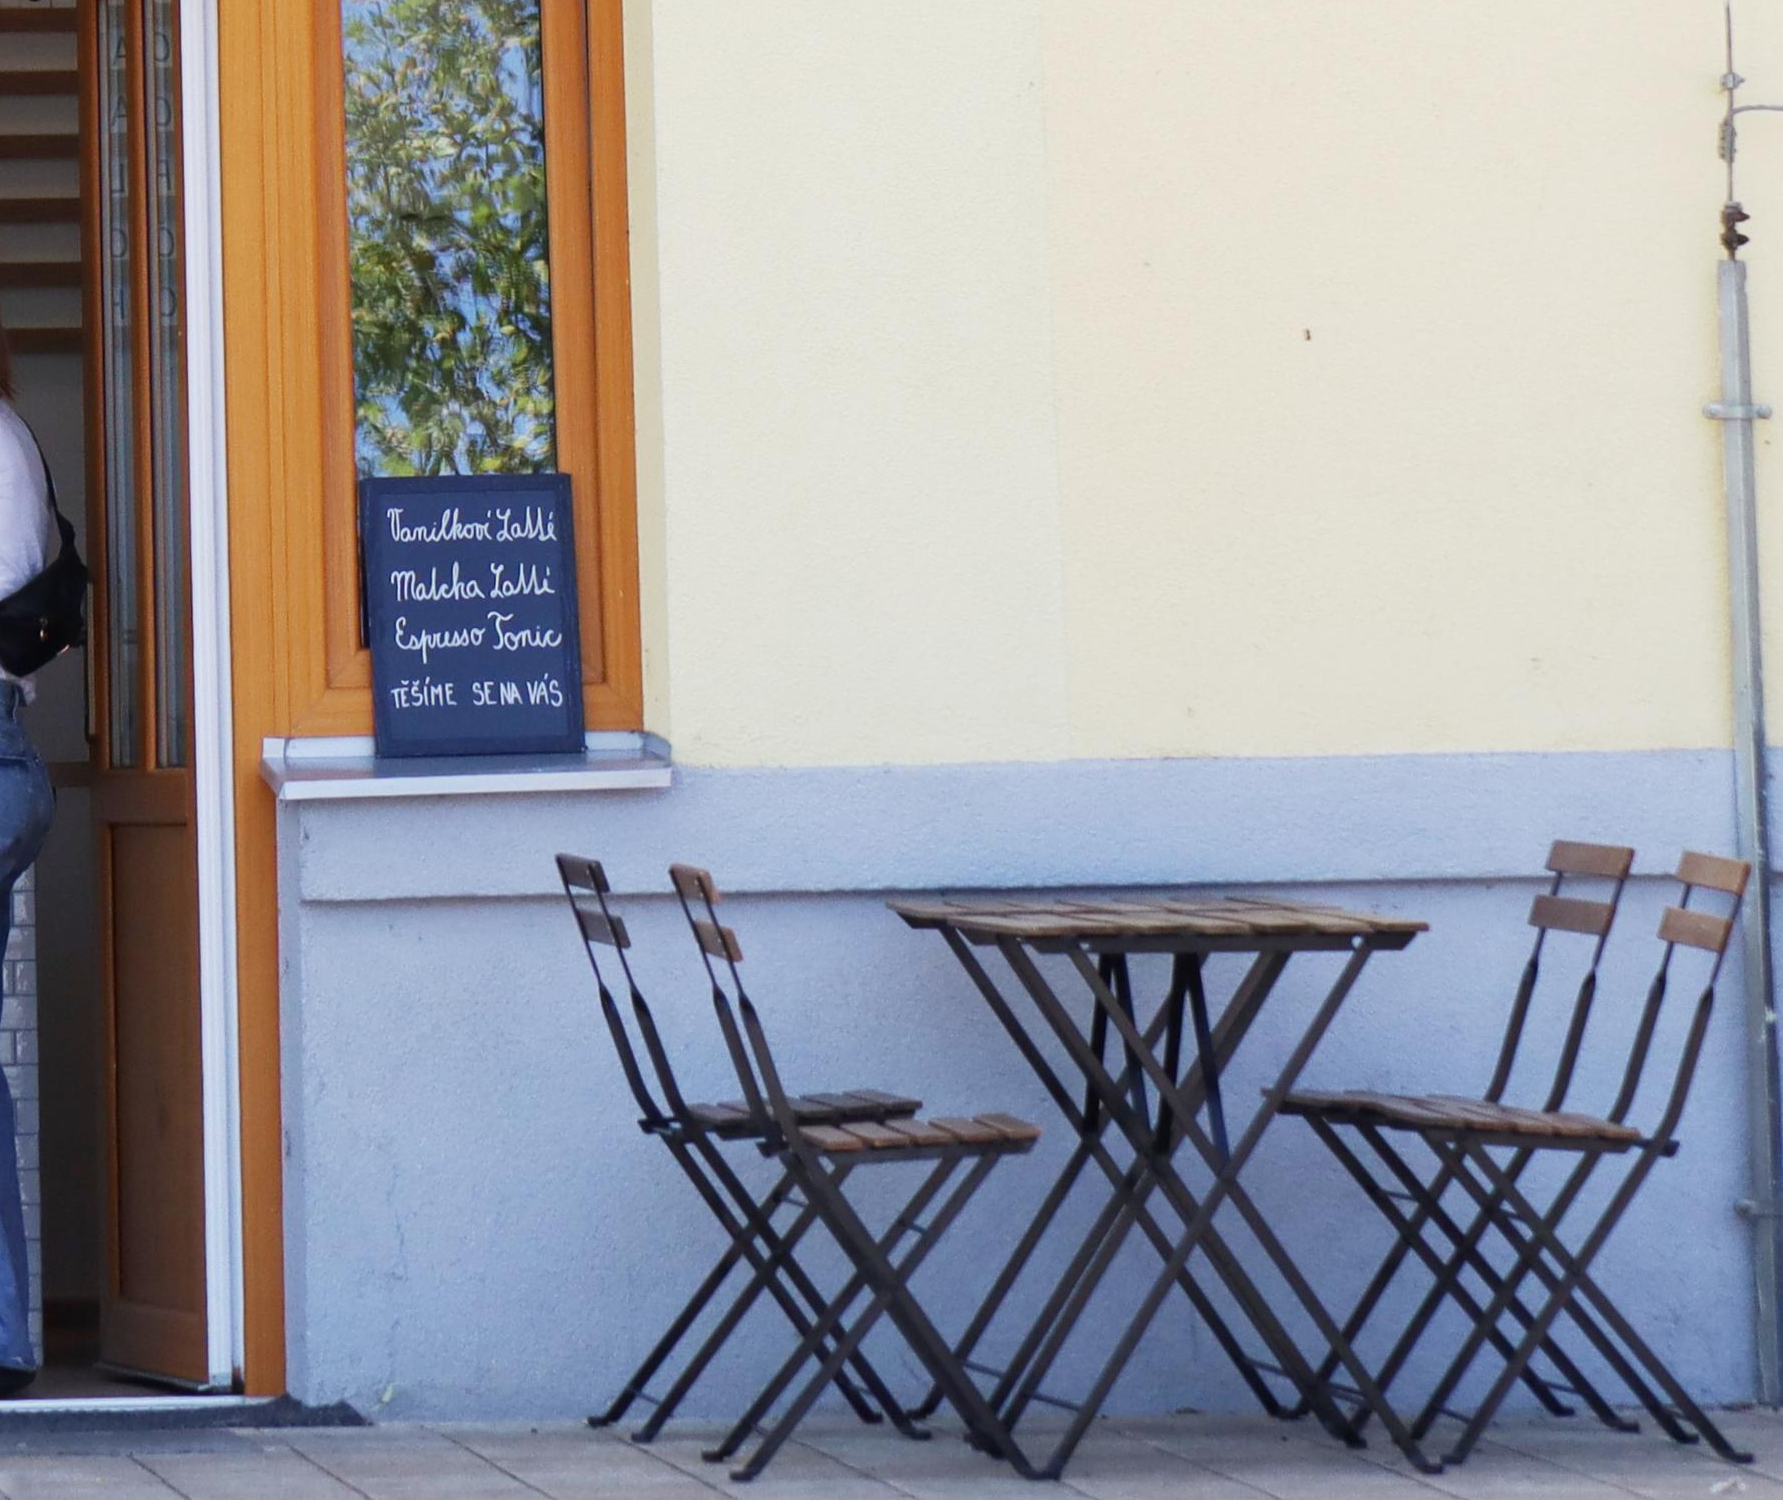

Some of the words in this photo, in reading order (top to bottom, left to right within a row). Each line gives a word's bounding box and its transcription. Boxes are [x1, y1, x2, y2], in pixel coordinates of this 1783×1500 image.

[390, 561, 486, 601] Matcha
[395, 616, 486, 664] Espresso
[487, 611, 563, 651] Tonic
[390, 676, 457, 709] TĚŠÍME
[526, 672, 563, 708] VÁS
